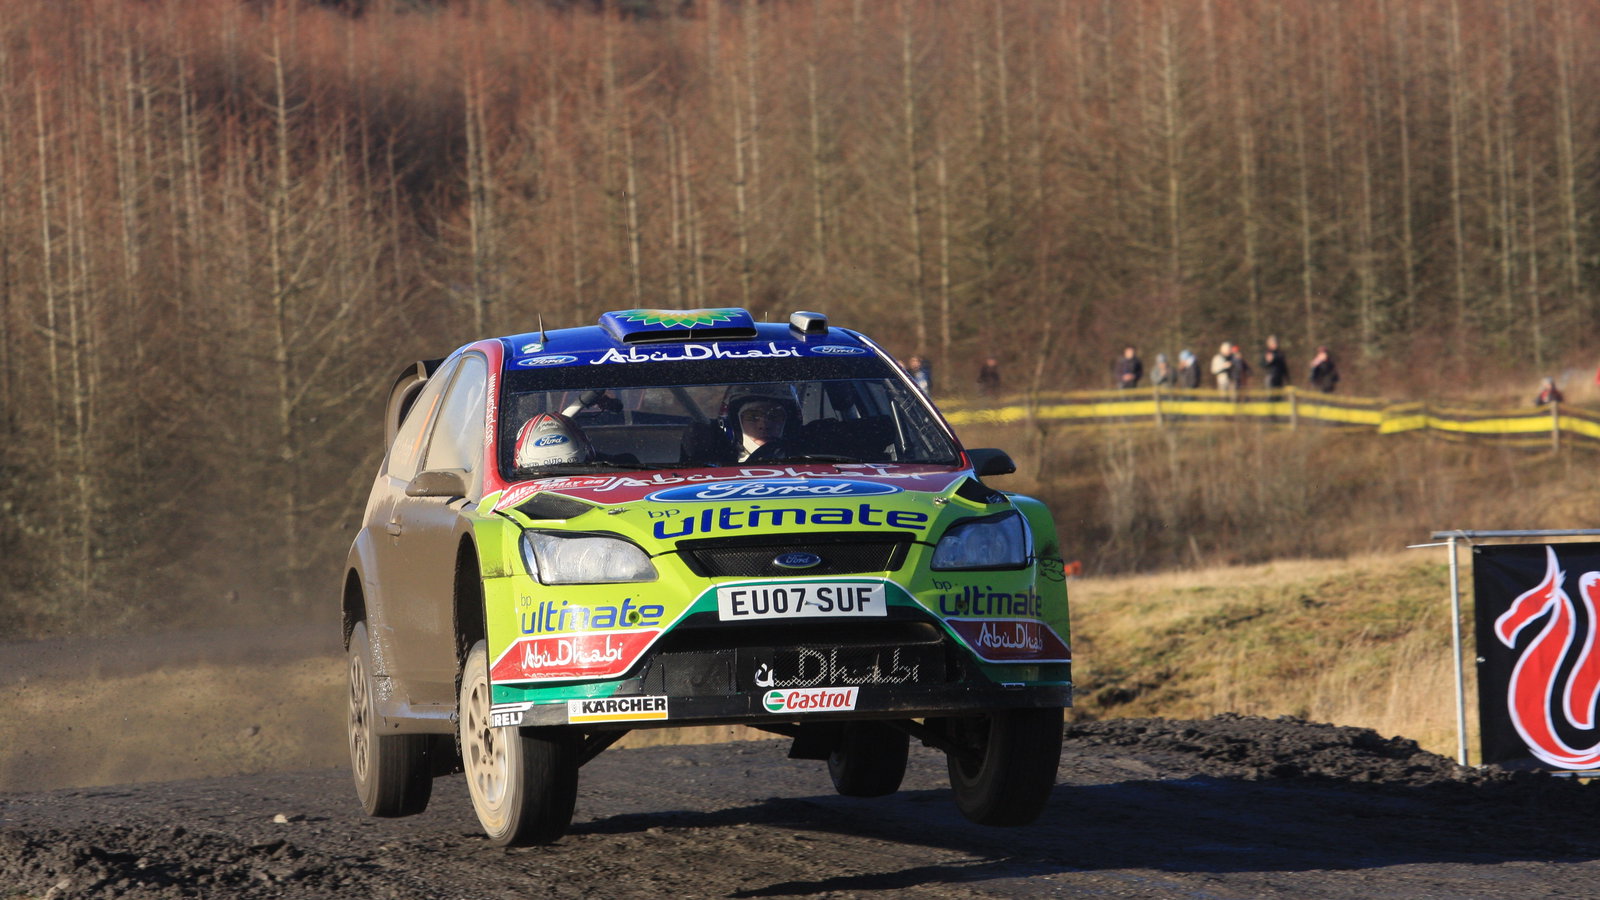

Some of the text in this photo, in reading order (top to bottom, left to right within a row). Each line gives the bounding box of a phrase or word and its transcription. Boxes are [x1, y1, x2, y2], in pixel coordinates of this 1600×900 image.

[526, 355, 570, 366] Ford
[539, 436, 563, 446] Ford
[696, 480, 854, 499] Ford
[648, 508, 681, 519] bp
[653, 504, 928, 540] ultimate
[932, 578, 952, 592] bp
[520, 593, 532, 608] bp
[731, 587, 872, 616] EU07 SUF
[521, 598, 664, 634] ultimate
[582, 698, 666, 713] KÄRCHER
[786, 690, 851, 709] Castrol
